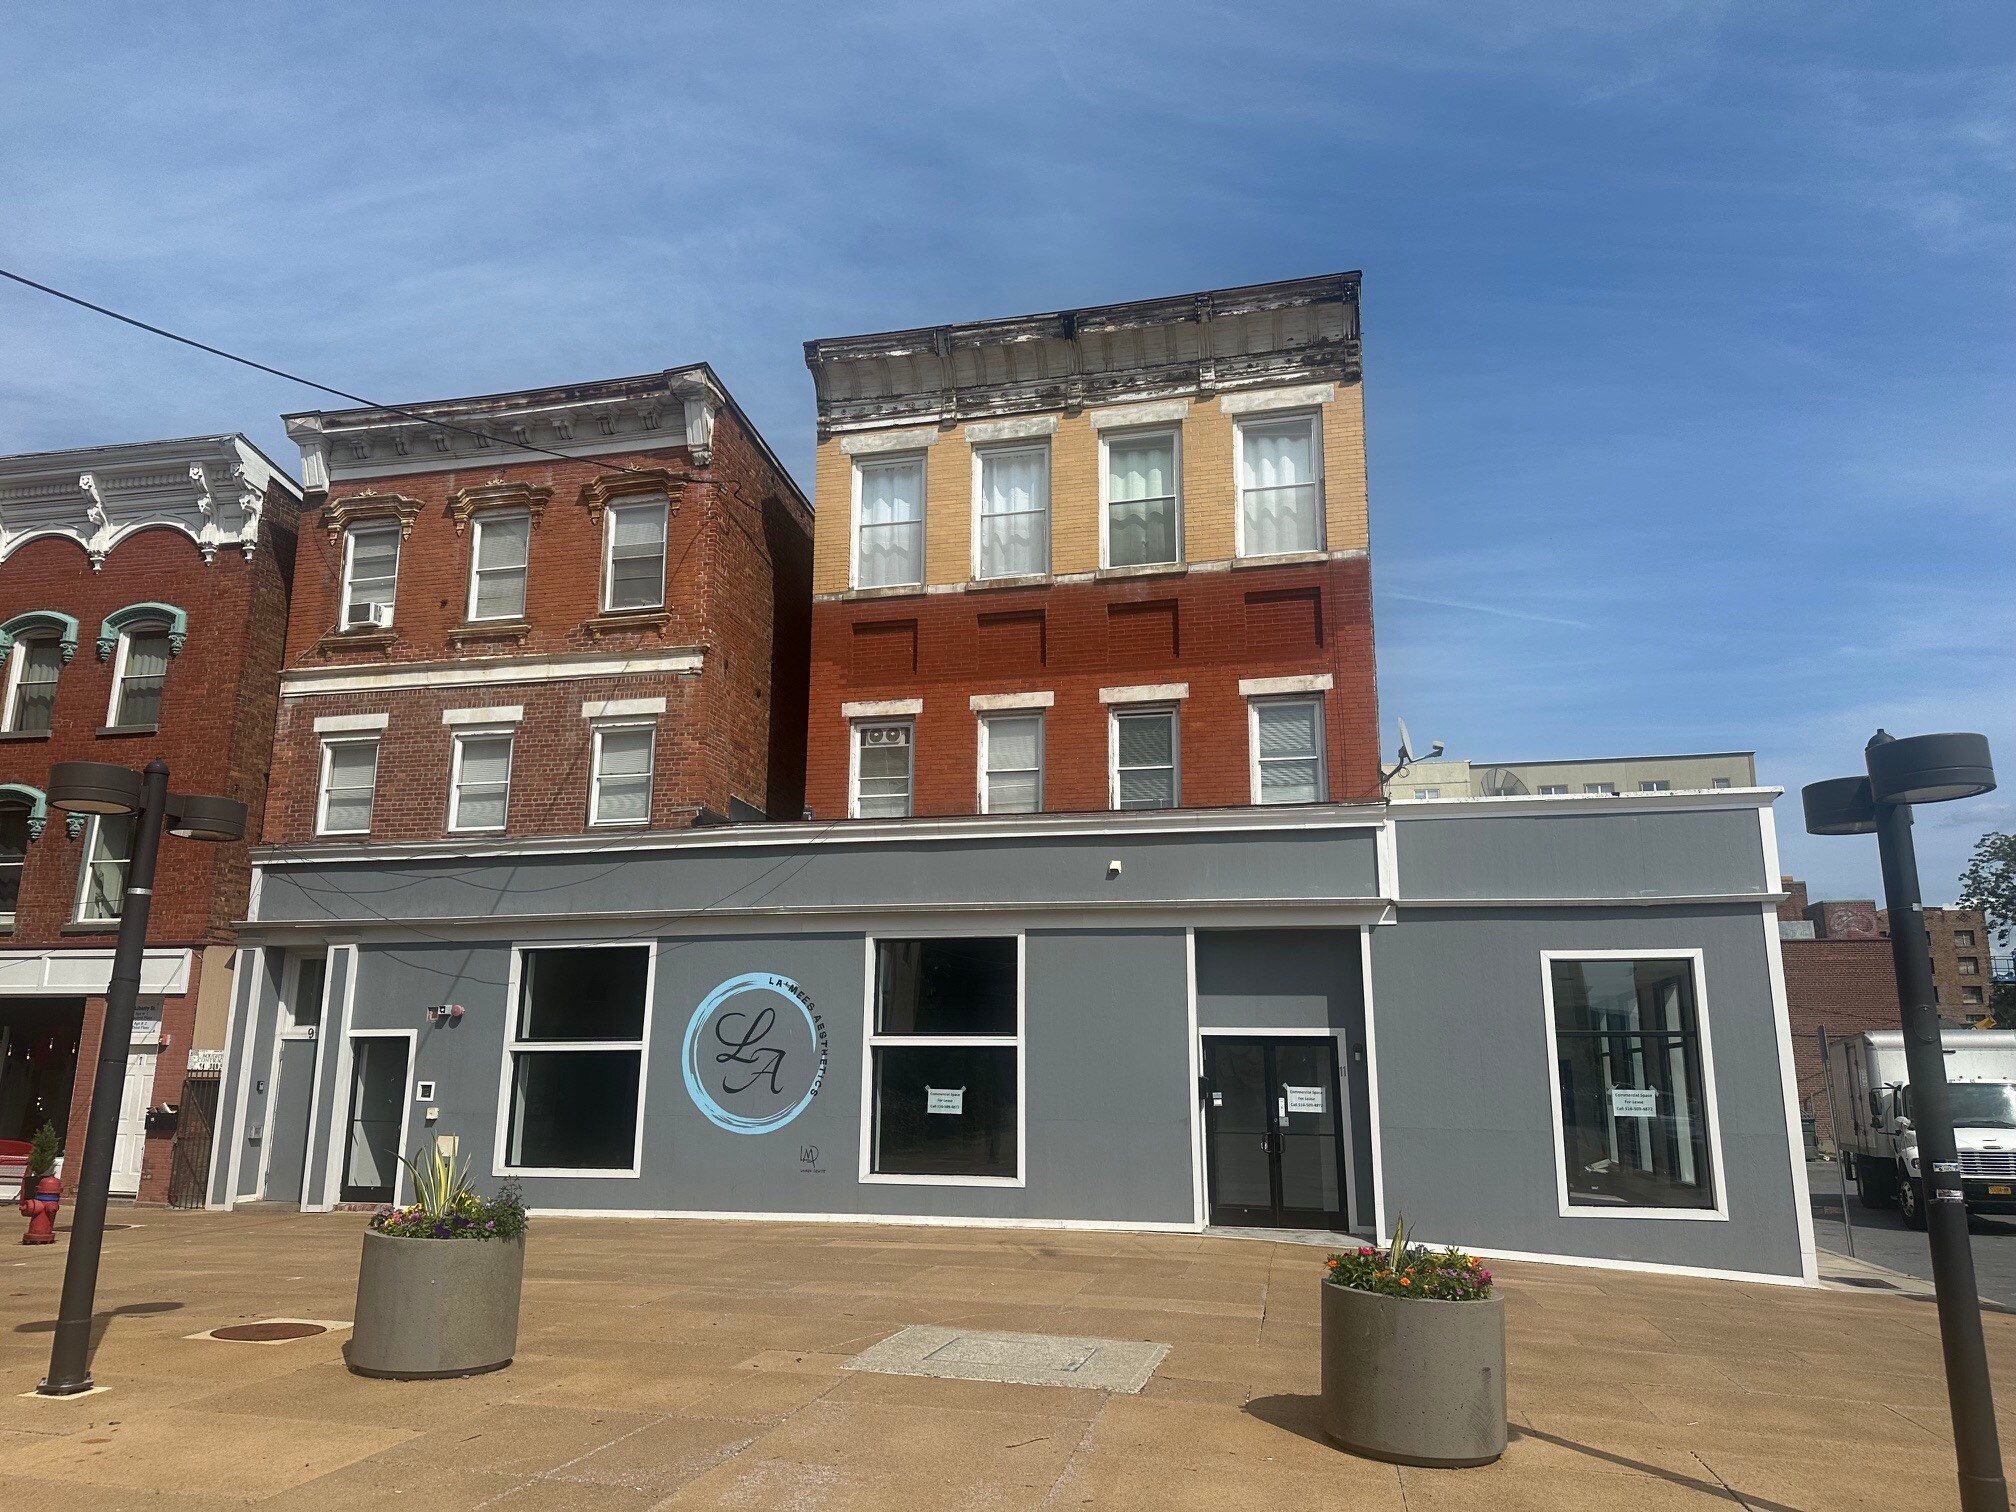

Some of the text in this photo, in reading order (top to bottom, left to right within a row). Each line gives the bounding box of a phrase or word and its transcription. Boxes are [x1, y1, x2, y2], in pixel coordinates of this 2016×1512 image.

[308, 1028, 314, 1039] 9
[810, 1015, 828, 1096] AESTHETICS
[1340, 1066, 1347, 1077] 11
